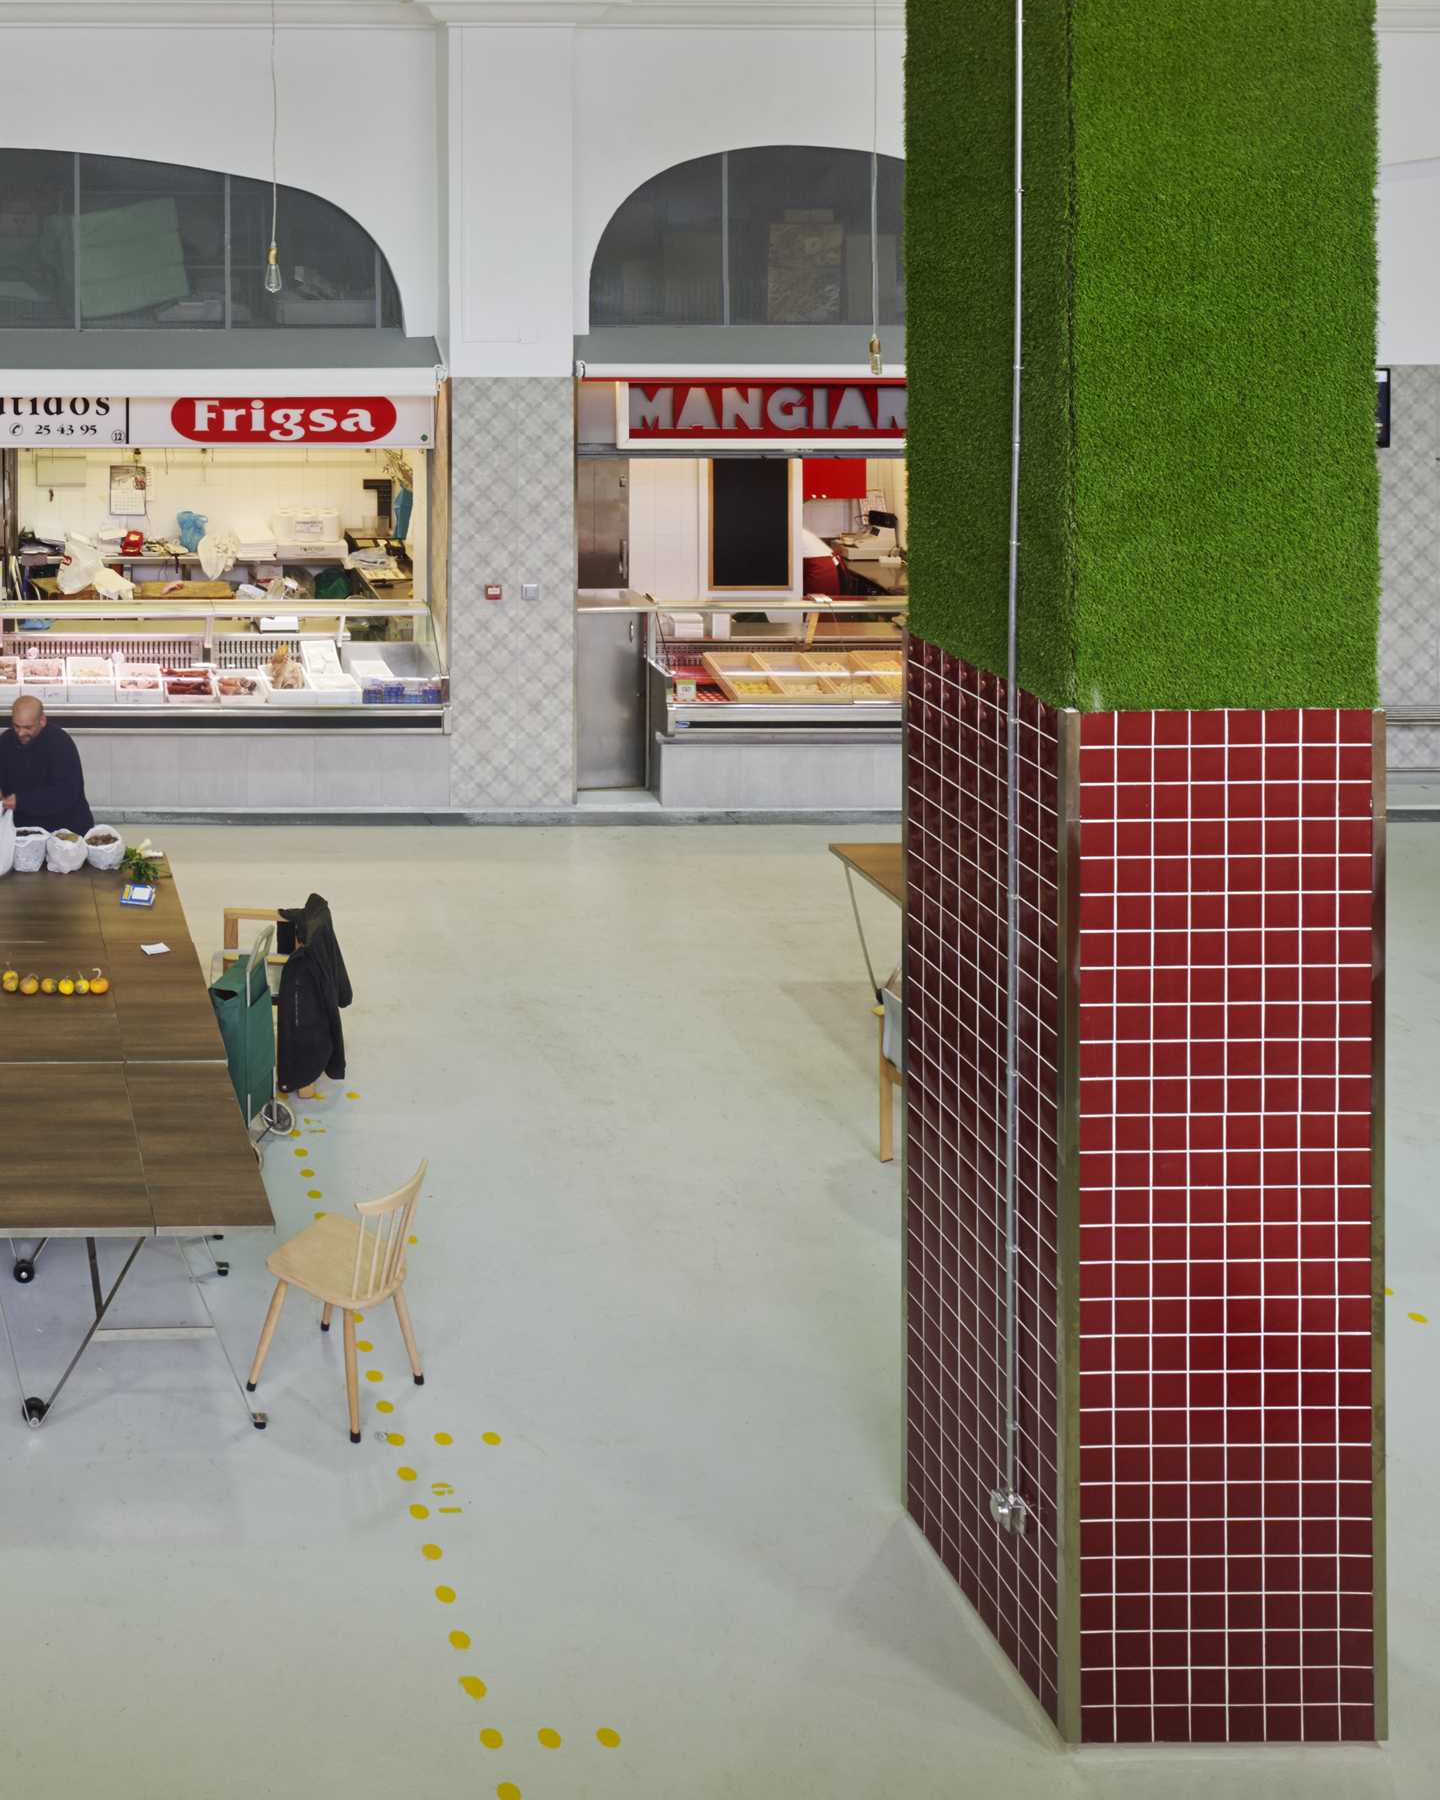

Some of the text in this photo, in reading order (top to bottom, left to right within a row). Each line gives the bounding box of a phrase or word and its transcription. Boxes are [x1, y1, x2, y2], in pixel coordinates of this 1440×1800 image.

[35, 424, 51, 436] 25
[57, 424, 74, 436] 43
[80, 424, 97, 436] 95
[193, 399, 376, 441] Frigsa
[629, 387, 907, 431] MANGIAR
